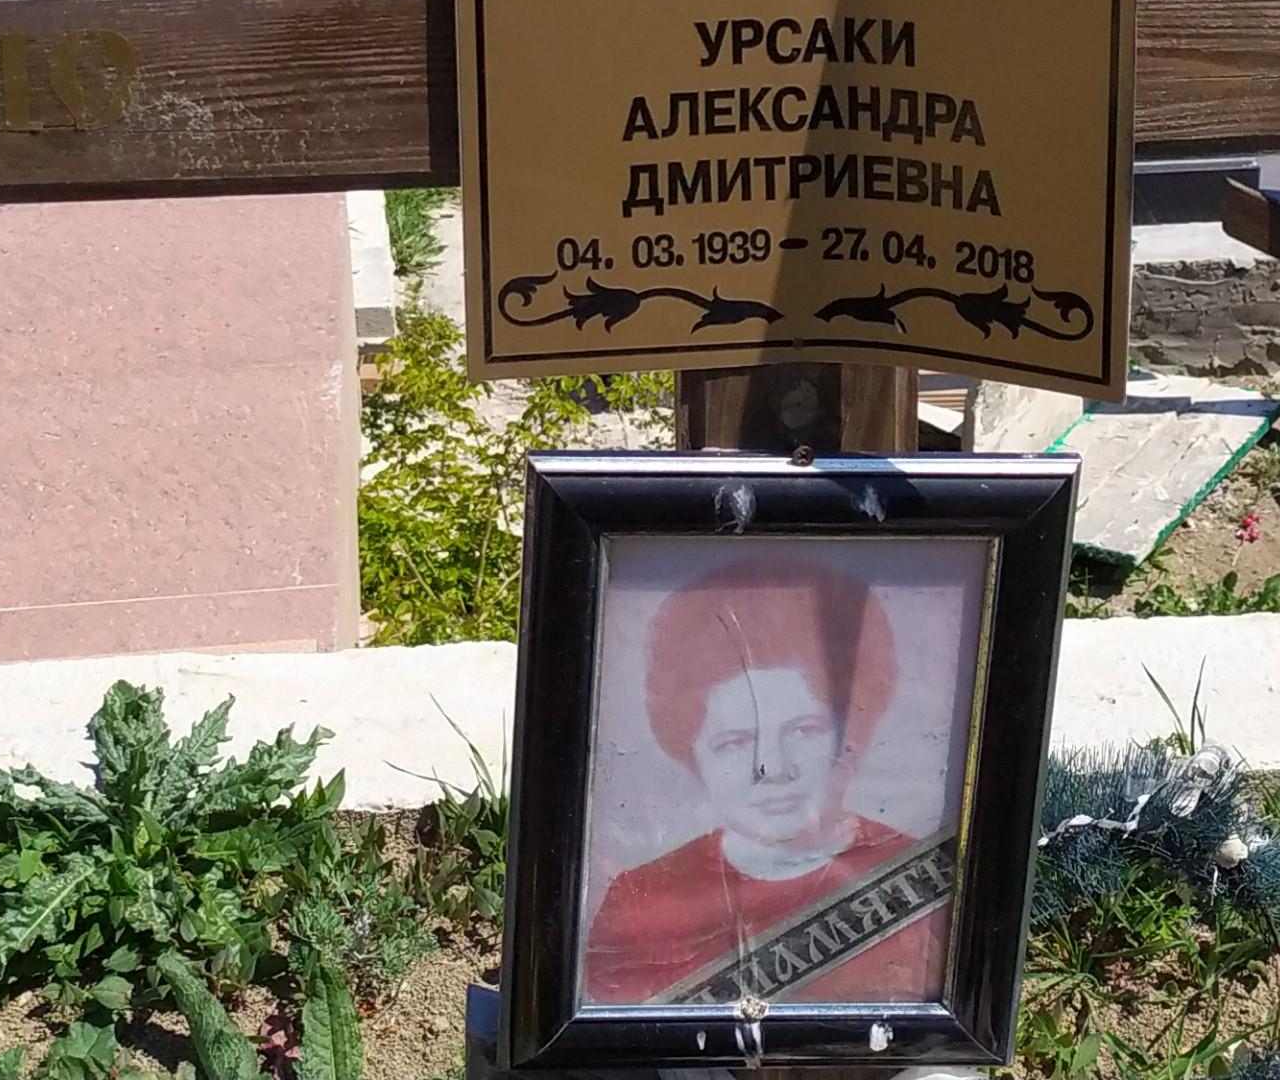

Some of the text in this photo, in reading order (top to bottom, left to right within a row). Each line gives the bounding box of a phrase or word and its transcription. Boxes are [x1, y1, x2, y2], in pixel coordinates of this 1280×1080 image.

[695, 17, 917, 67] УРСАКИ
[621, 85, 986, 146] АЛЕКСАНДРА
[621, 153, 1002, 218] ДМИТРИЕВНА
[955, 244, 1035, 284] 2018
